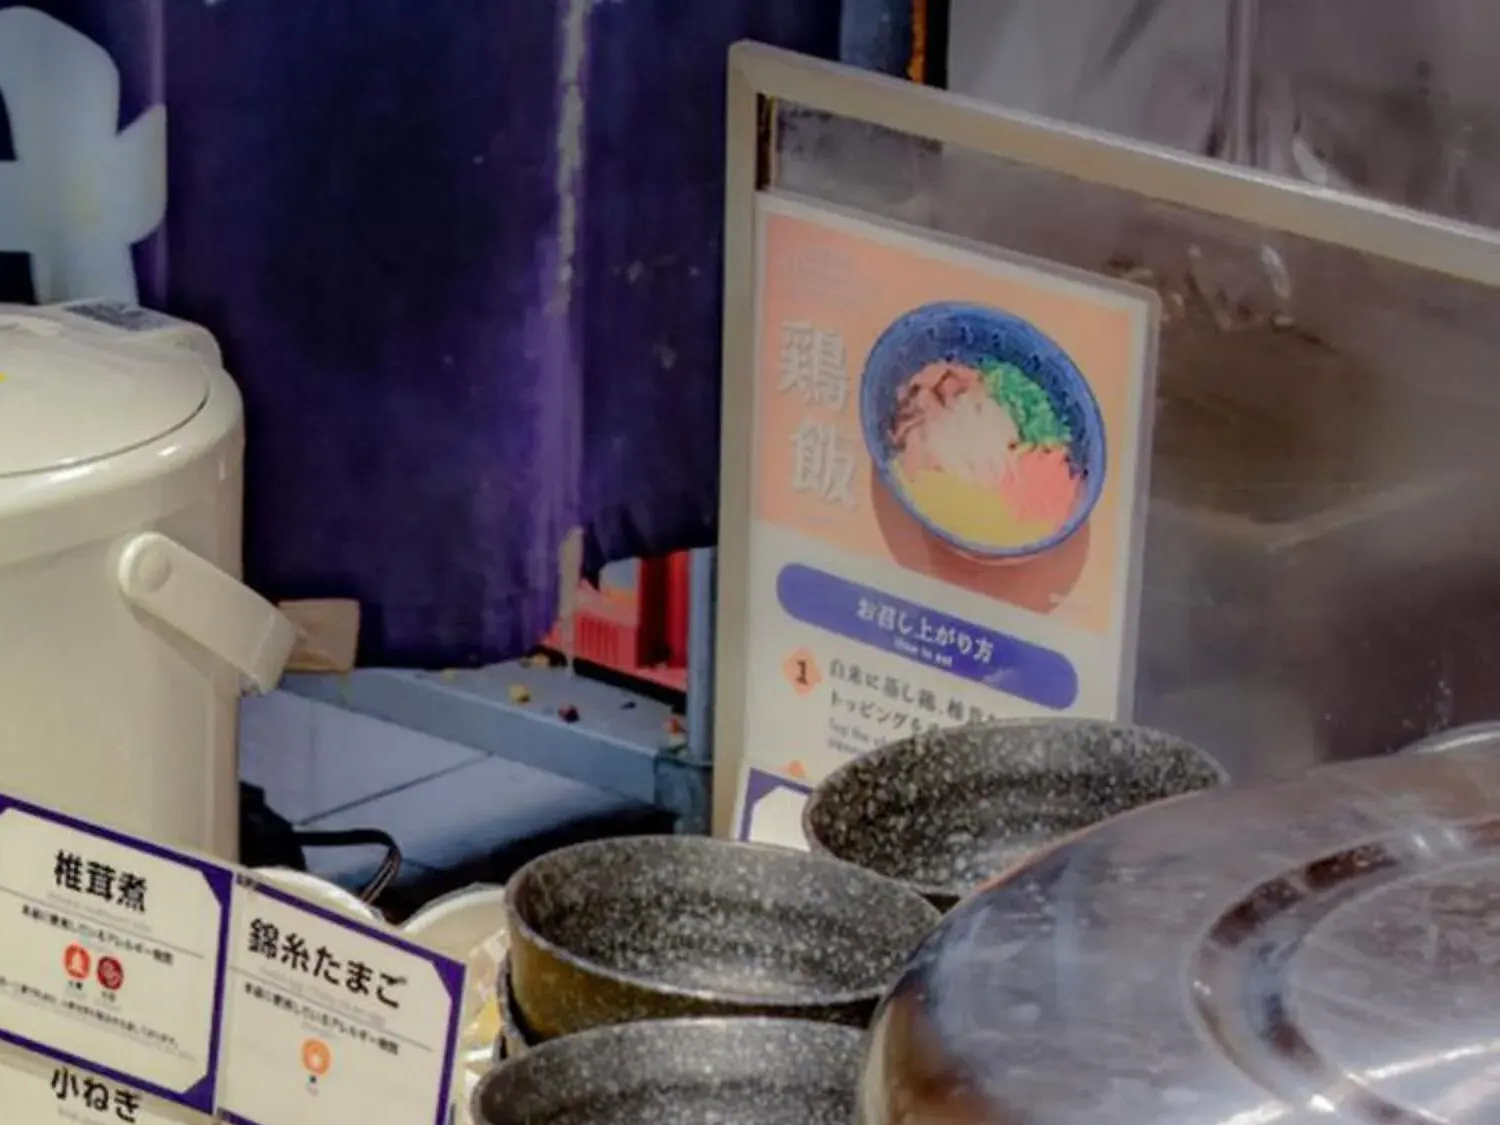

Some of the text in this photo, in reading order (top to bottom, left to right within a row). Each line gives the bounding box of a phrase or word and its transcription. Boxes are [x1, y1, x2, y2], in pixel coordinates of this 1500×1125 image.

[777, 318, 860, 510] 鶏飯
[856, 598, 995, 664] お召し上がり方
[794, 659, 809, 687] 1
[52, 849, 149, 913] 椎茸煮
[247, 917, 408, 1010] 錦糸たまご
[51, 1066, 141, 1124] 小ねぎ
